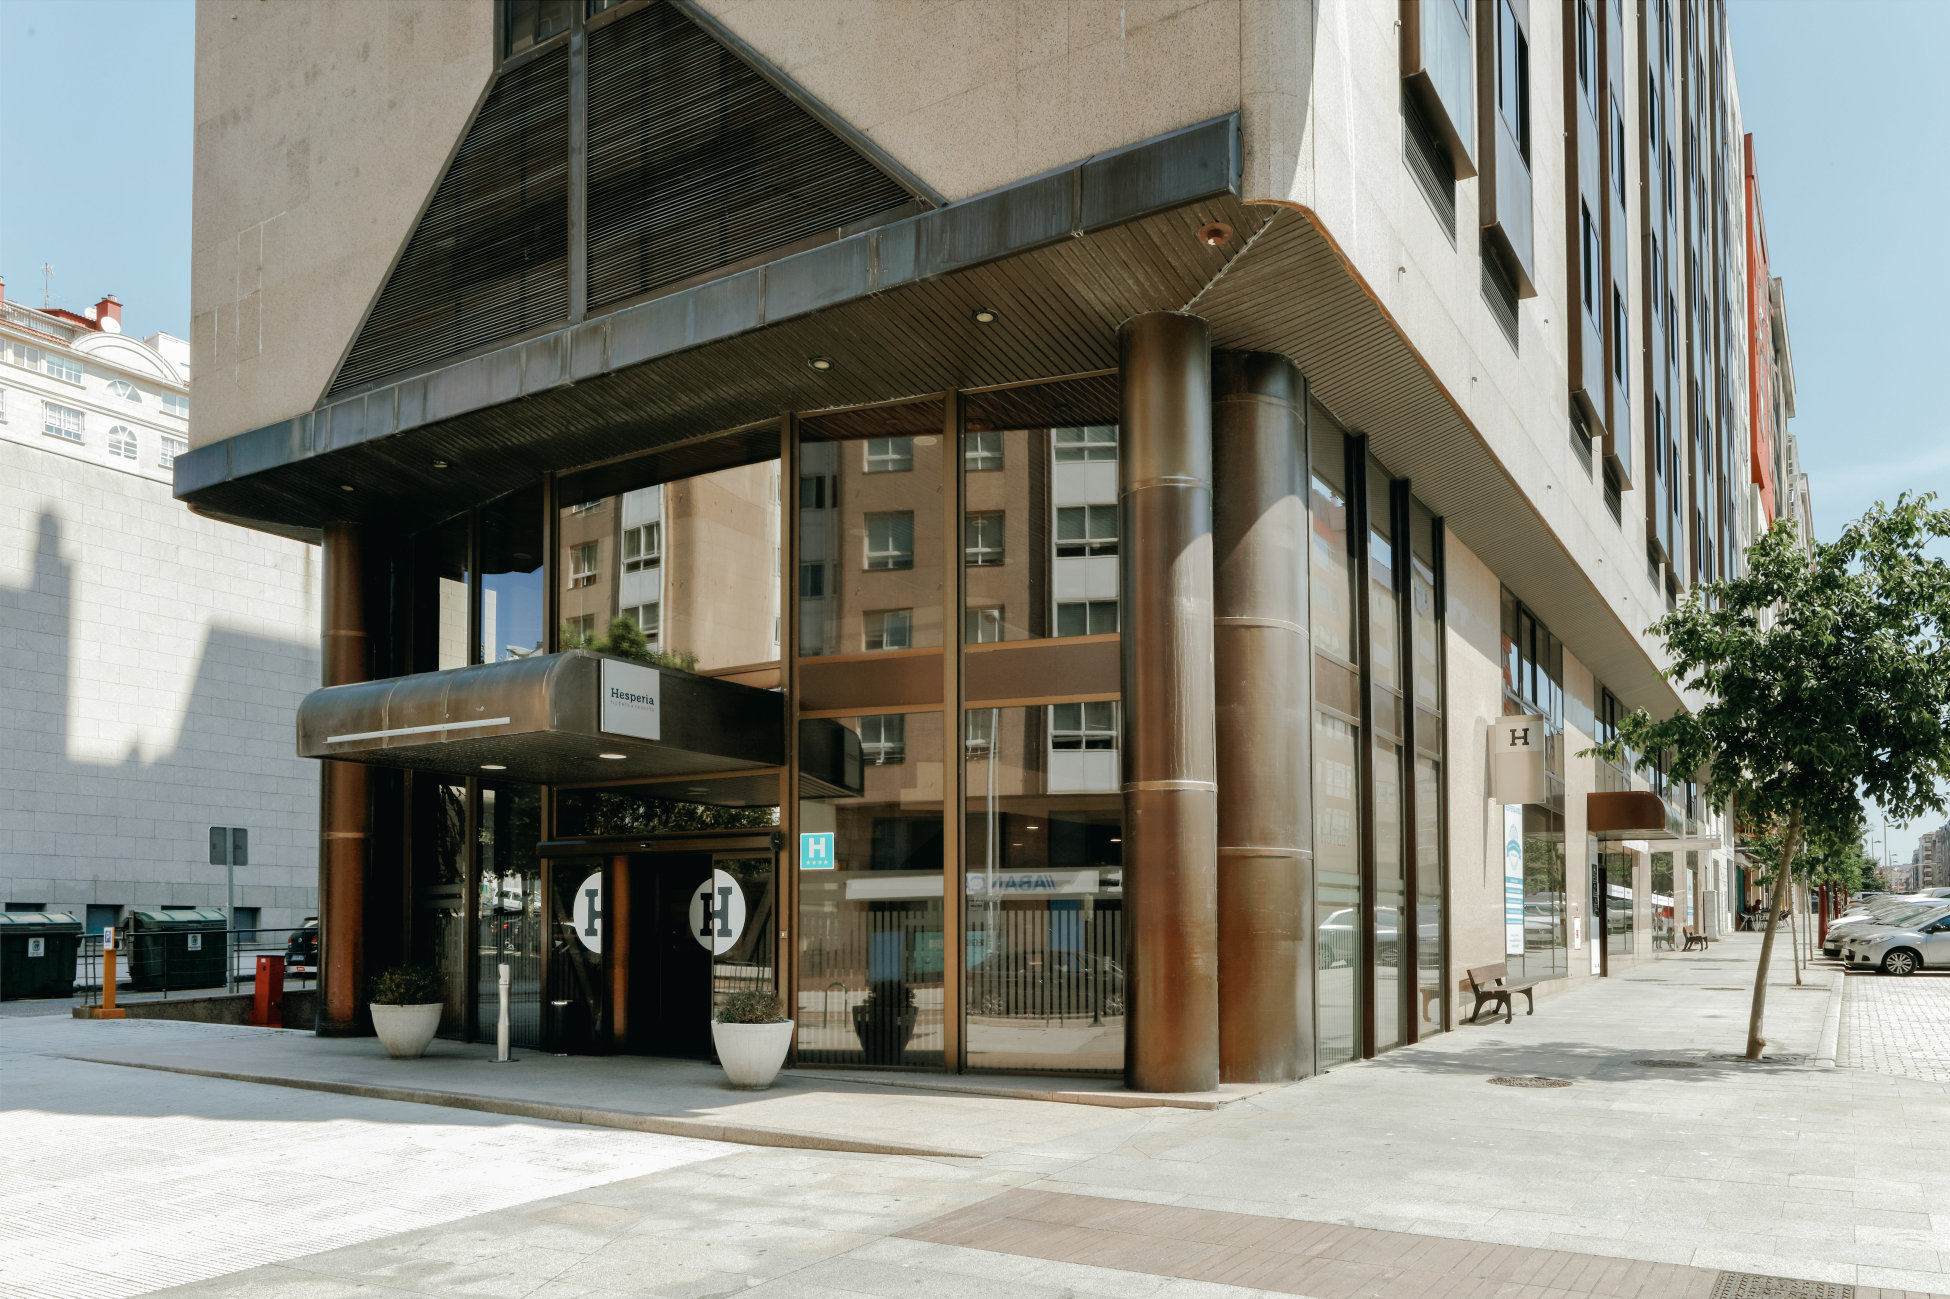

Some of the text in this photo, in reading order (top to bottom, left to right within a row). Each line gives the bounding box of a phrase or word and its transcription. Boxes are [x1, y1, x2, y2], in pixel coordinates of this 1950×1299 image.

[611, 687, 654, 705] Hesperia
[1510, 727, 1529, 746] H
[808, 837, 826, 858] H
